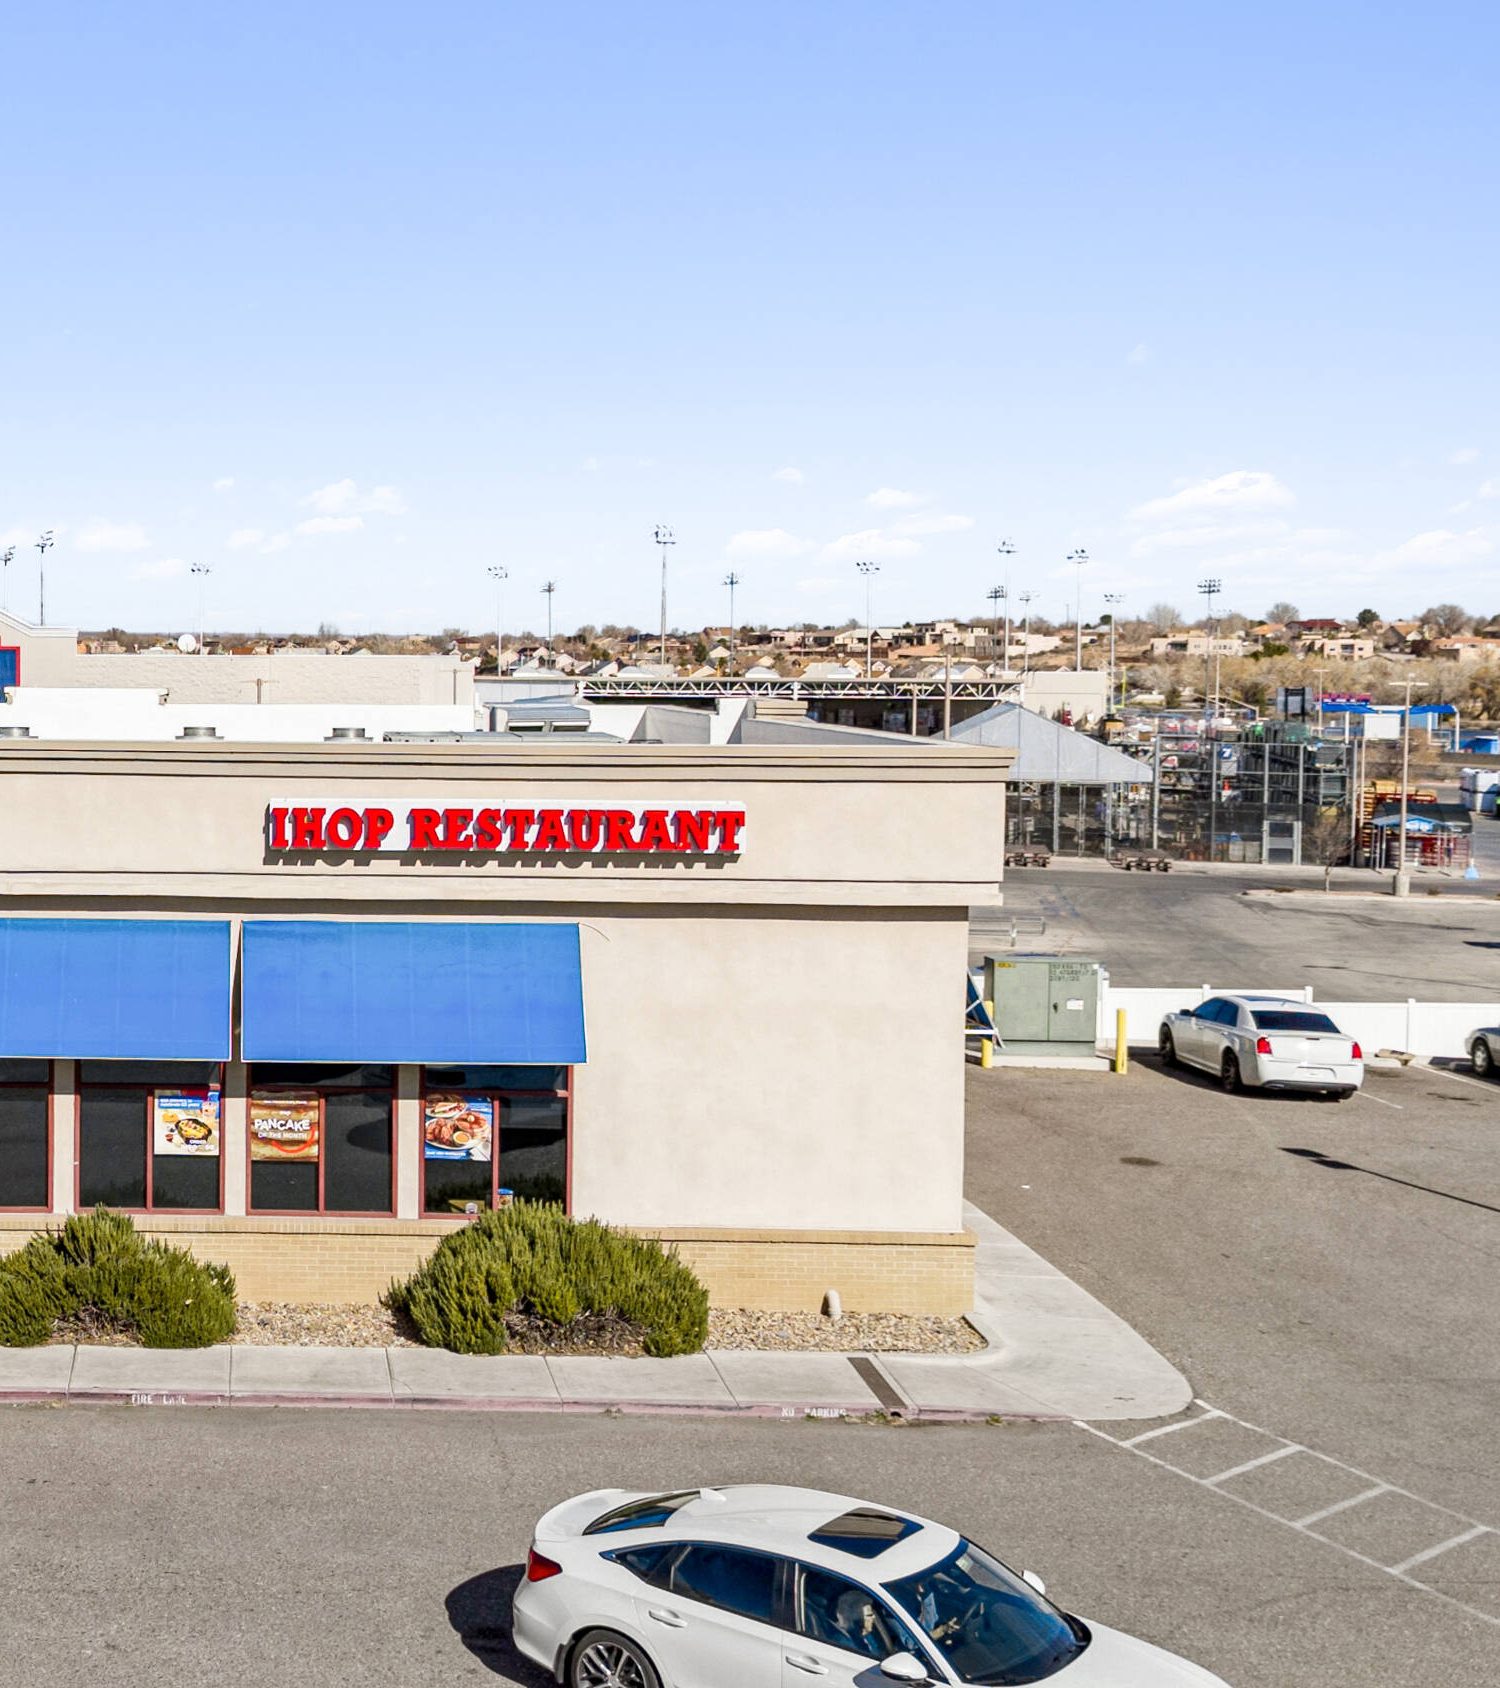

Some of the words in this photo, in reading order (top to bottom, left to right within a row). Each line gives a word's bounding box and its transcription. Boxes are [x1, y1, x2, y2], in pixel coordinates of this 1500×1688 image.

[271, 806, 395, 850] IHOP
[409, 807, 746, 852] RESTAURANT
[254, 1117, 311, 1132] PANCAKE
[131, 1393, 153, 1404] FIRE
[781, 1406, 795, 1417] NO
